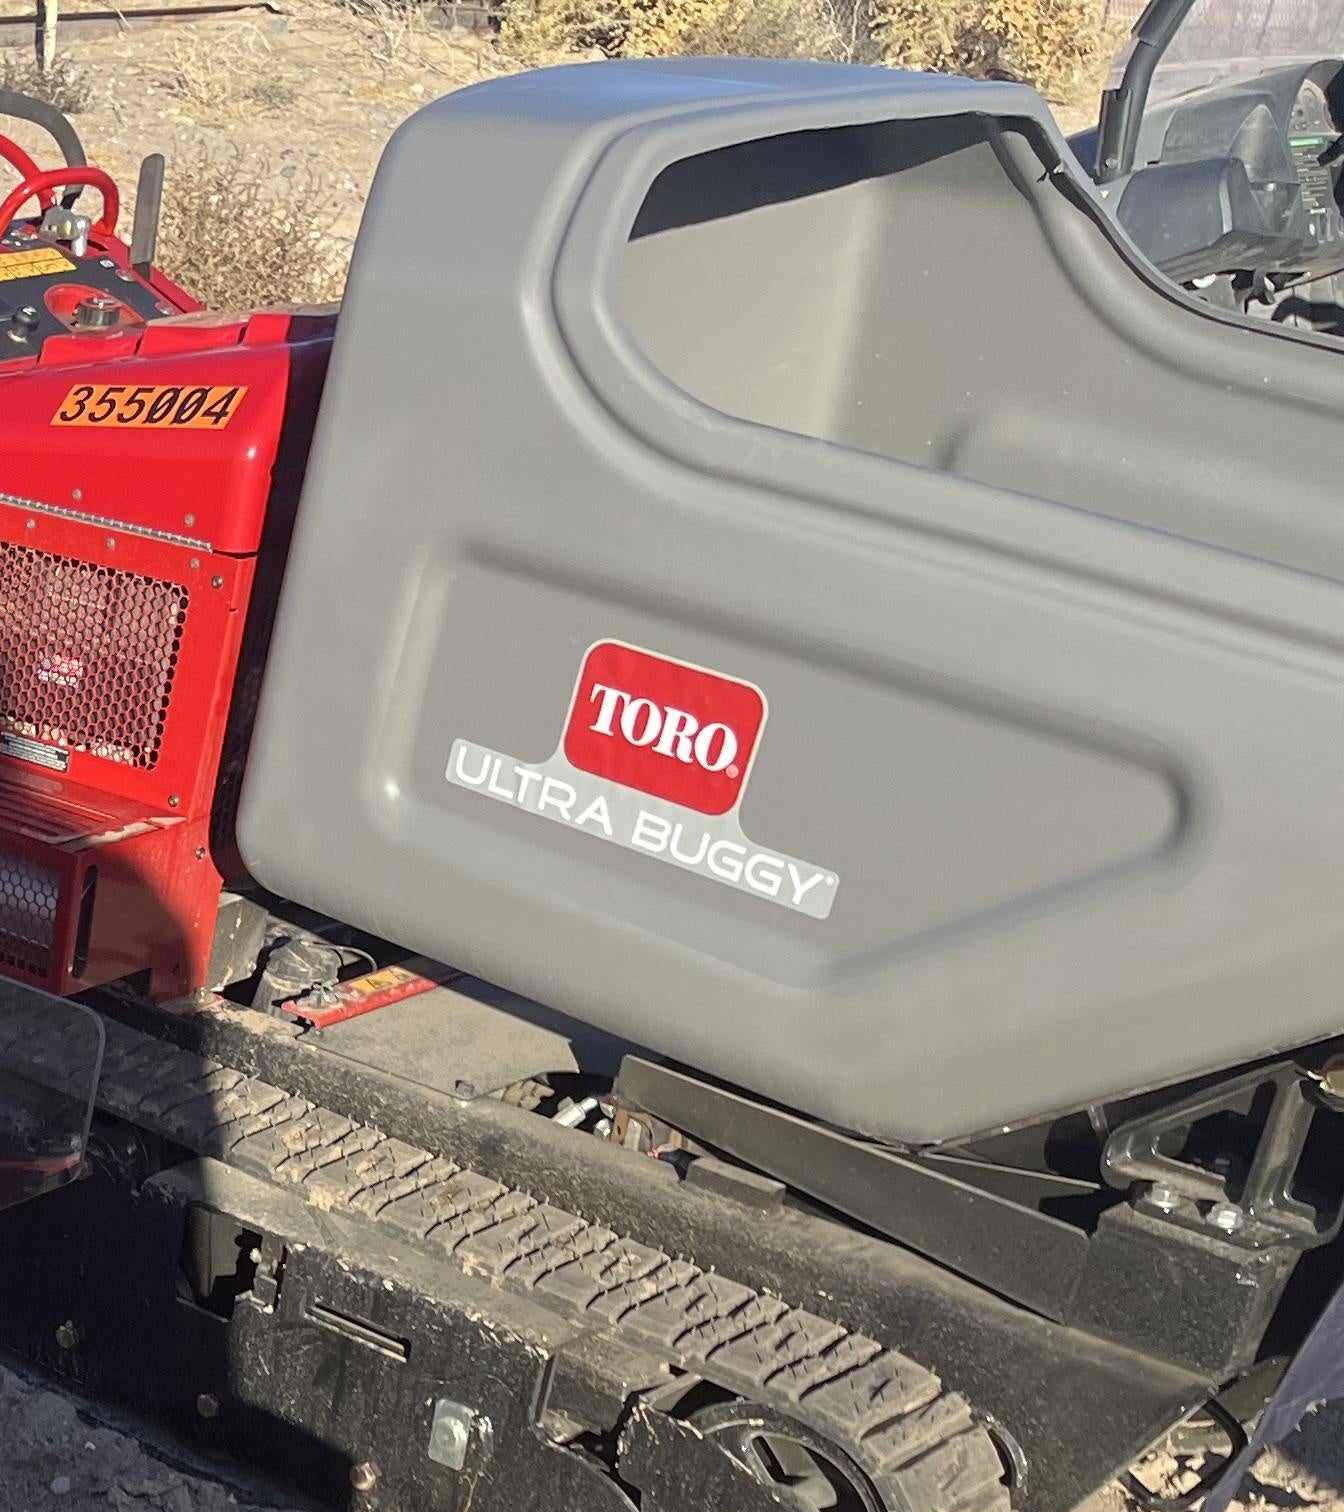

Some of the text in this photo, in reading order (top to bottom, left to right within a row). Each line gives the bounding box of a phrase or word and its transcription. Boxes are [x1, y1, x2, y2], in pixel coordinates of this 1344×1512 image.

[60, 386, 240, 425] 355004
[588, 682, 739, 774] TORO
[454, 744, 825, 906] ULTRA BUGGY
